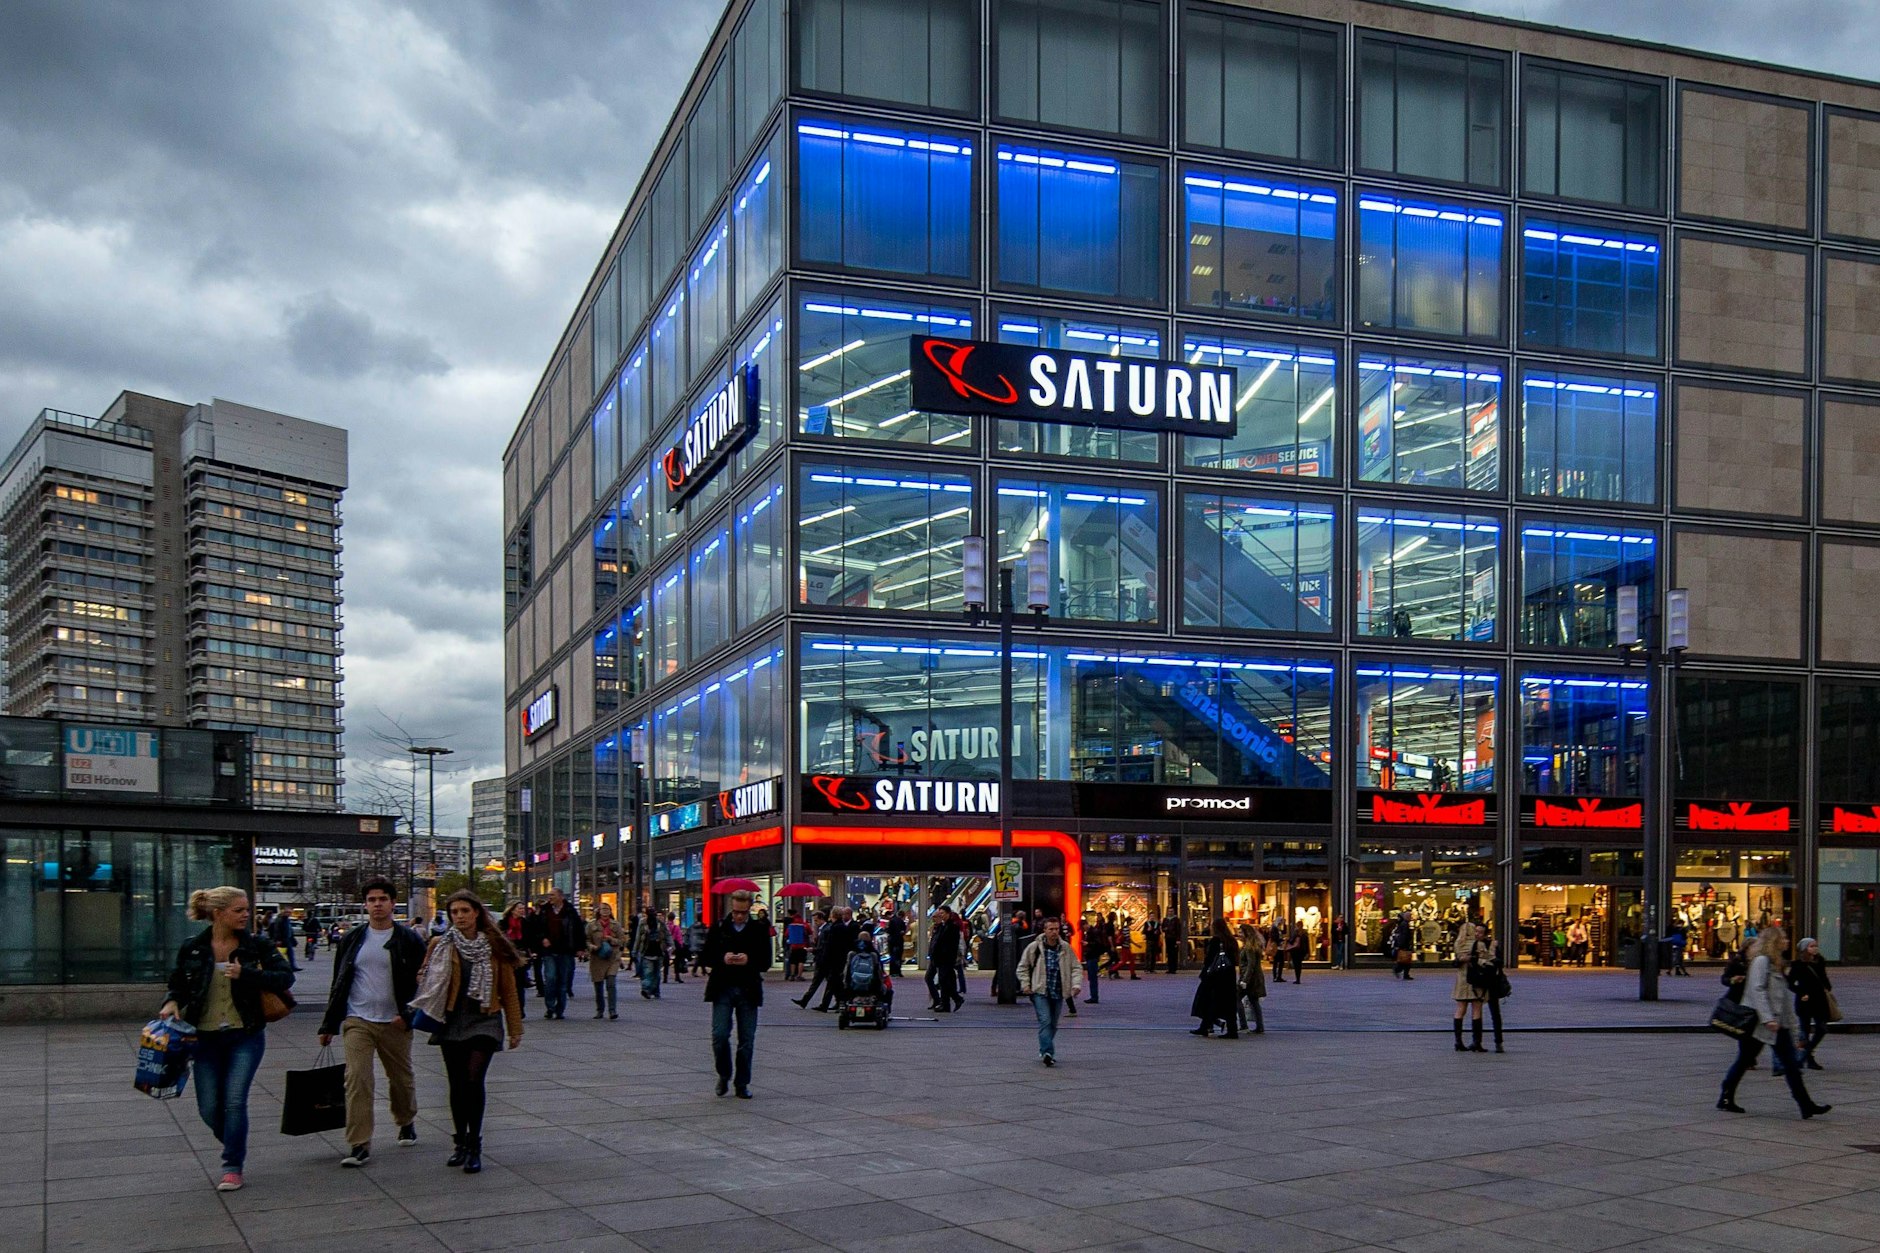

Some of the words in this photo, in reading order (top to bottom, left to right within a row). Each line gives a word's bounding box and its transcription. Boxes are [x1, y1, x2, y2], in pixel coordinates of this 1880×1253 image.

[1030, 354, 1231, 423] SATURN
[685, 374, 739, 477] SATURN
[1167, 668, 1278, 764] Panasonic
[70, 729, 94, 753] U
[94, 774, 137, 786] Hönow
[875, 779, 1000, 813] SATURN
[735, 780, 773, 818] SATURN
[1166, 797, 1250, 810] promod
